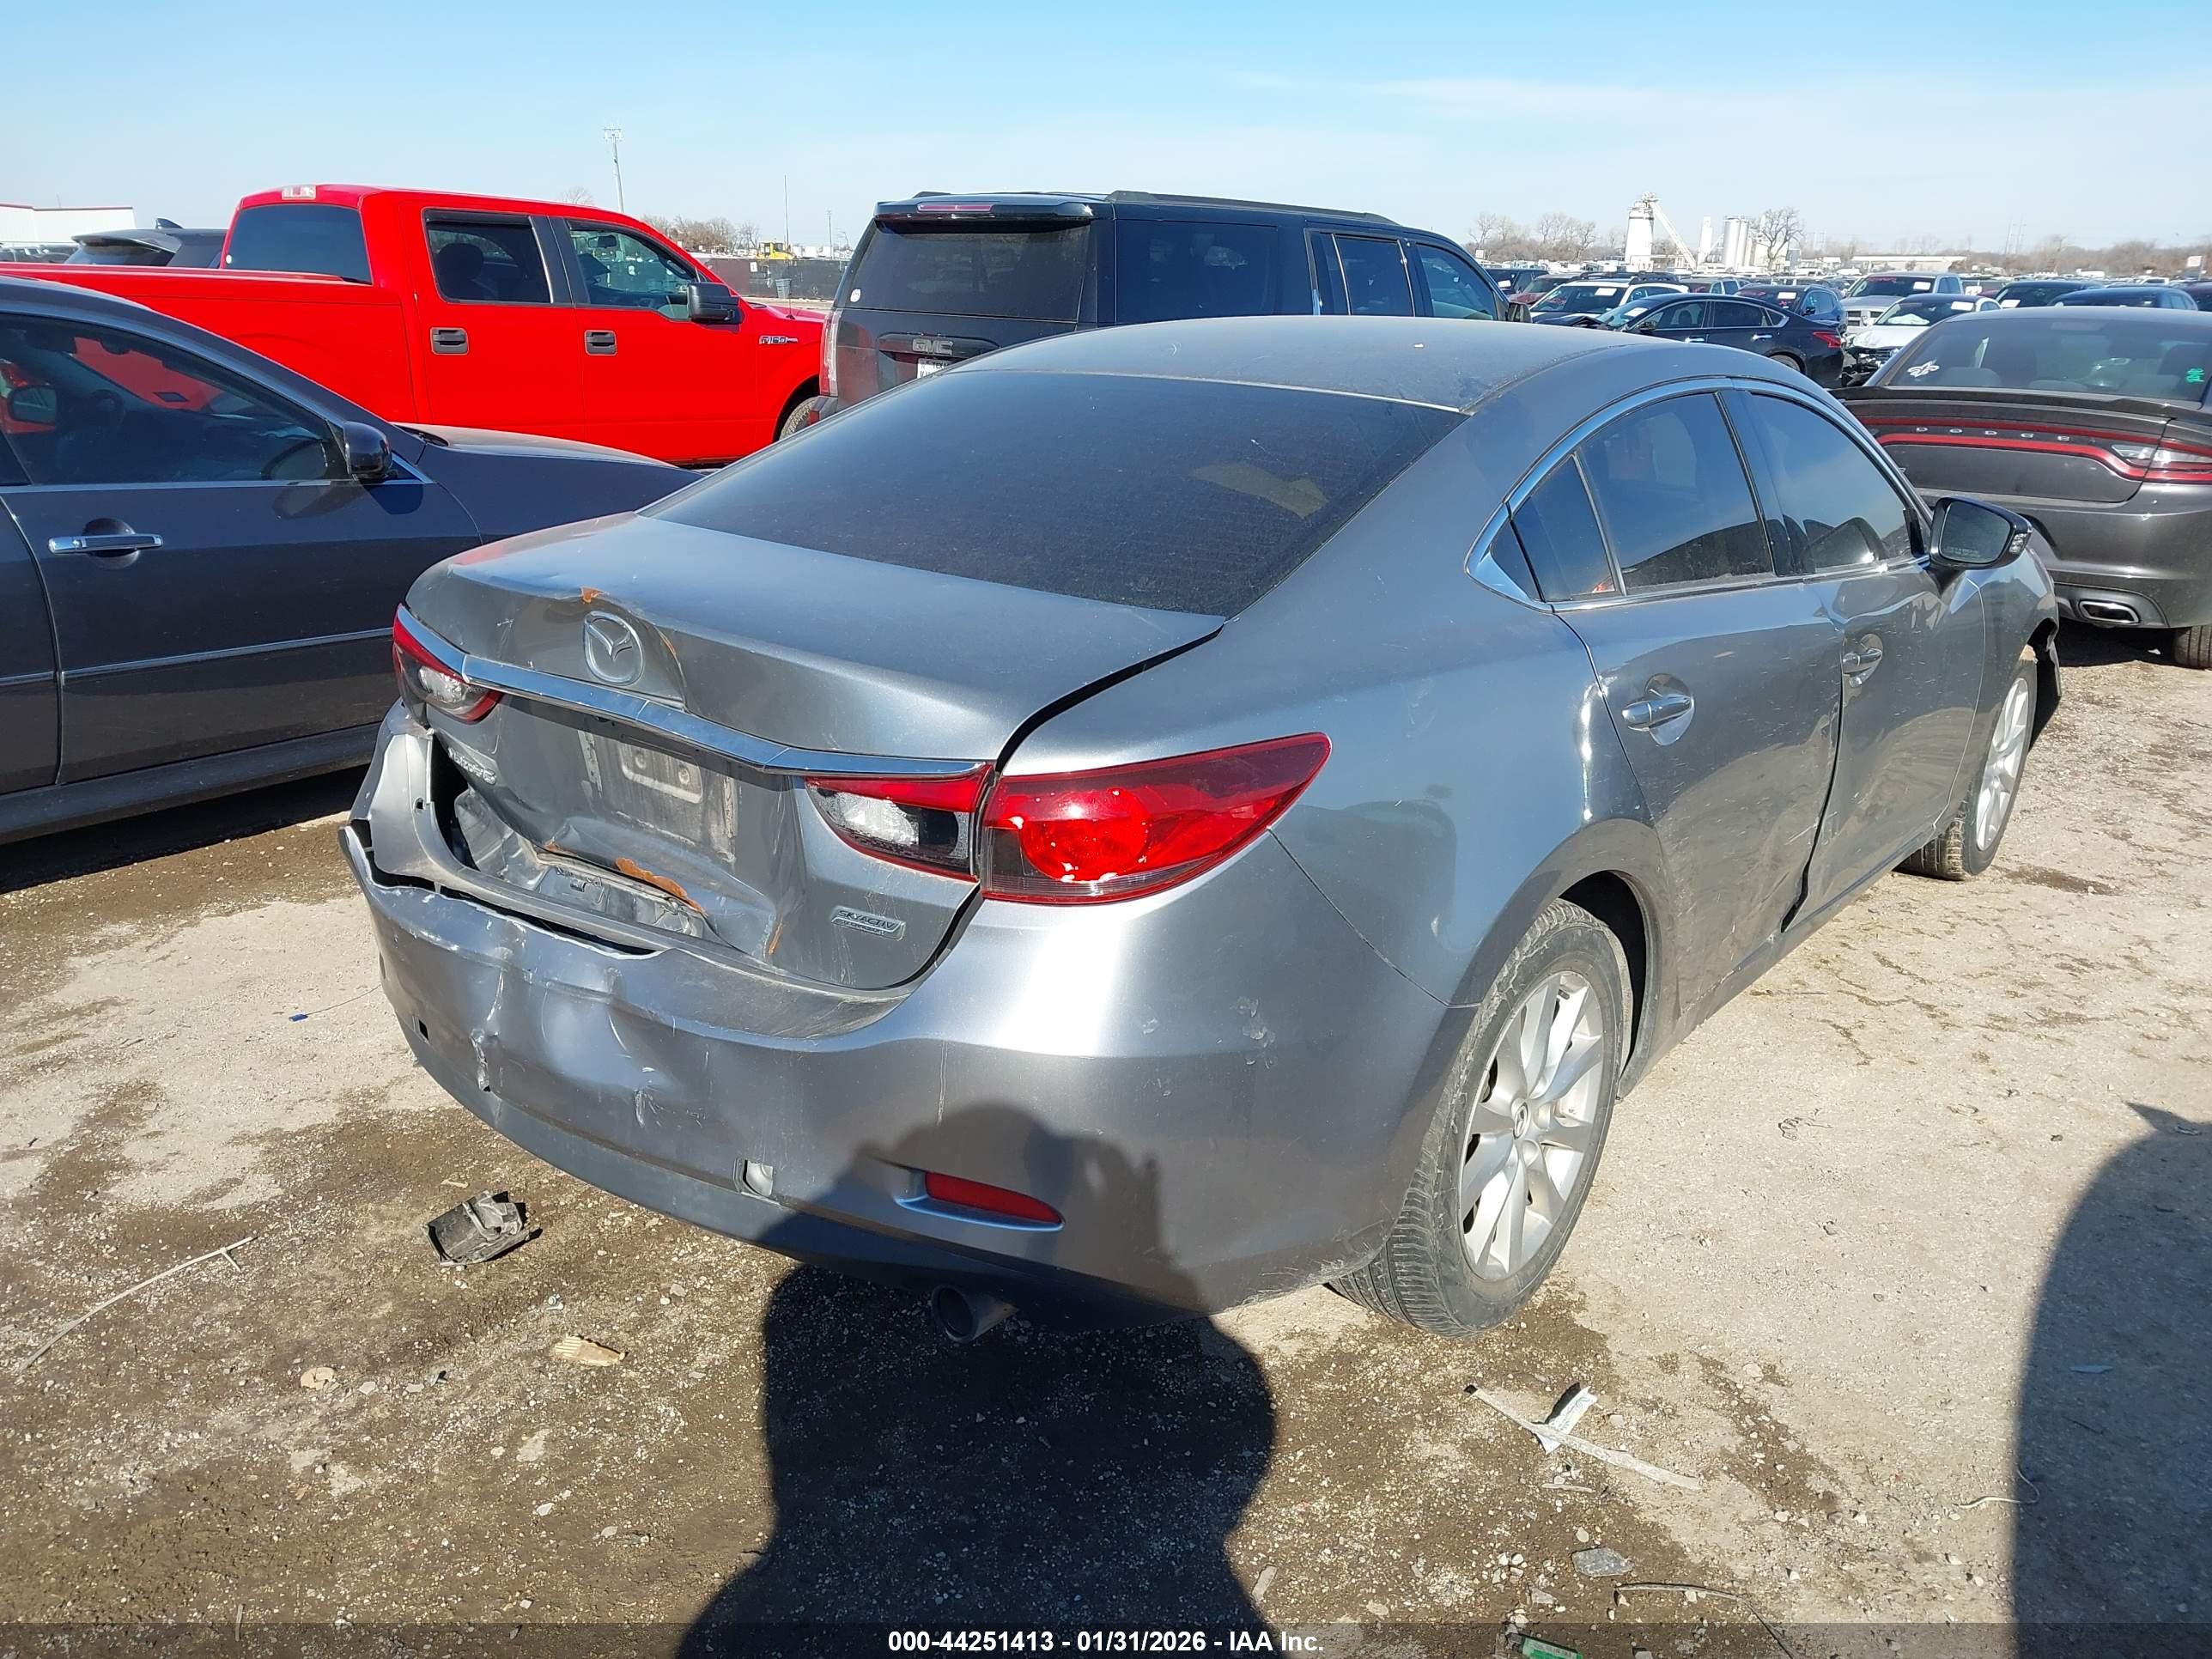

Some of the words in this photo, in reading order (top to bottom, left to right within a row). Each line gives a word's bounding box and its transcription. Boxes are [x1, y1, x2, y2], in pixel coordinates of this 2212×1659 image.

[913, 338, 953, 356] GMC
[1916, 427, 2070, 442] DODGE
[838, 909, 896, 929] SKYACTIV
